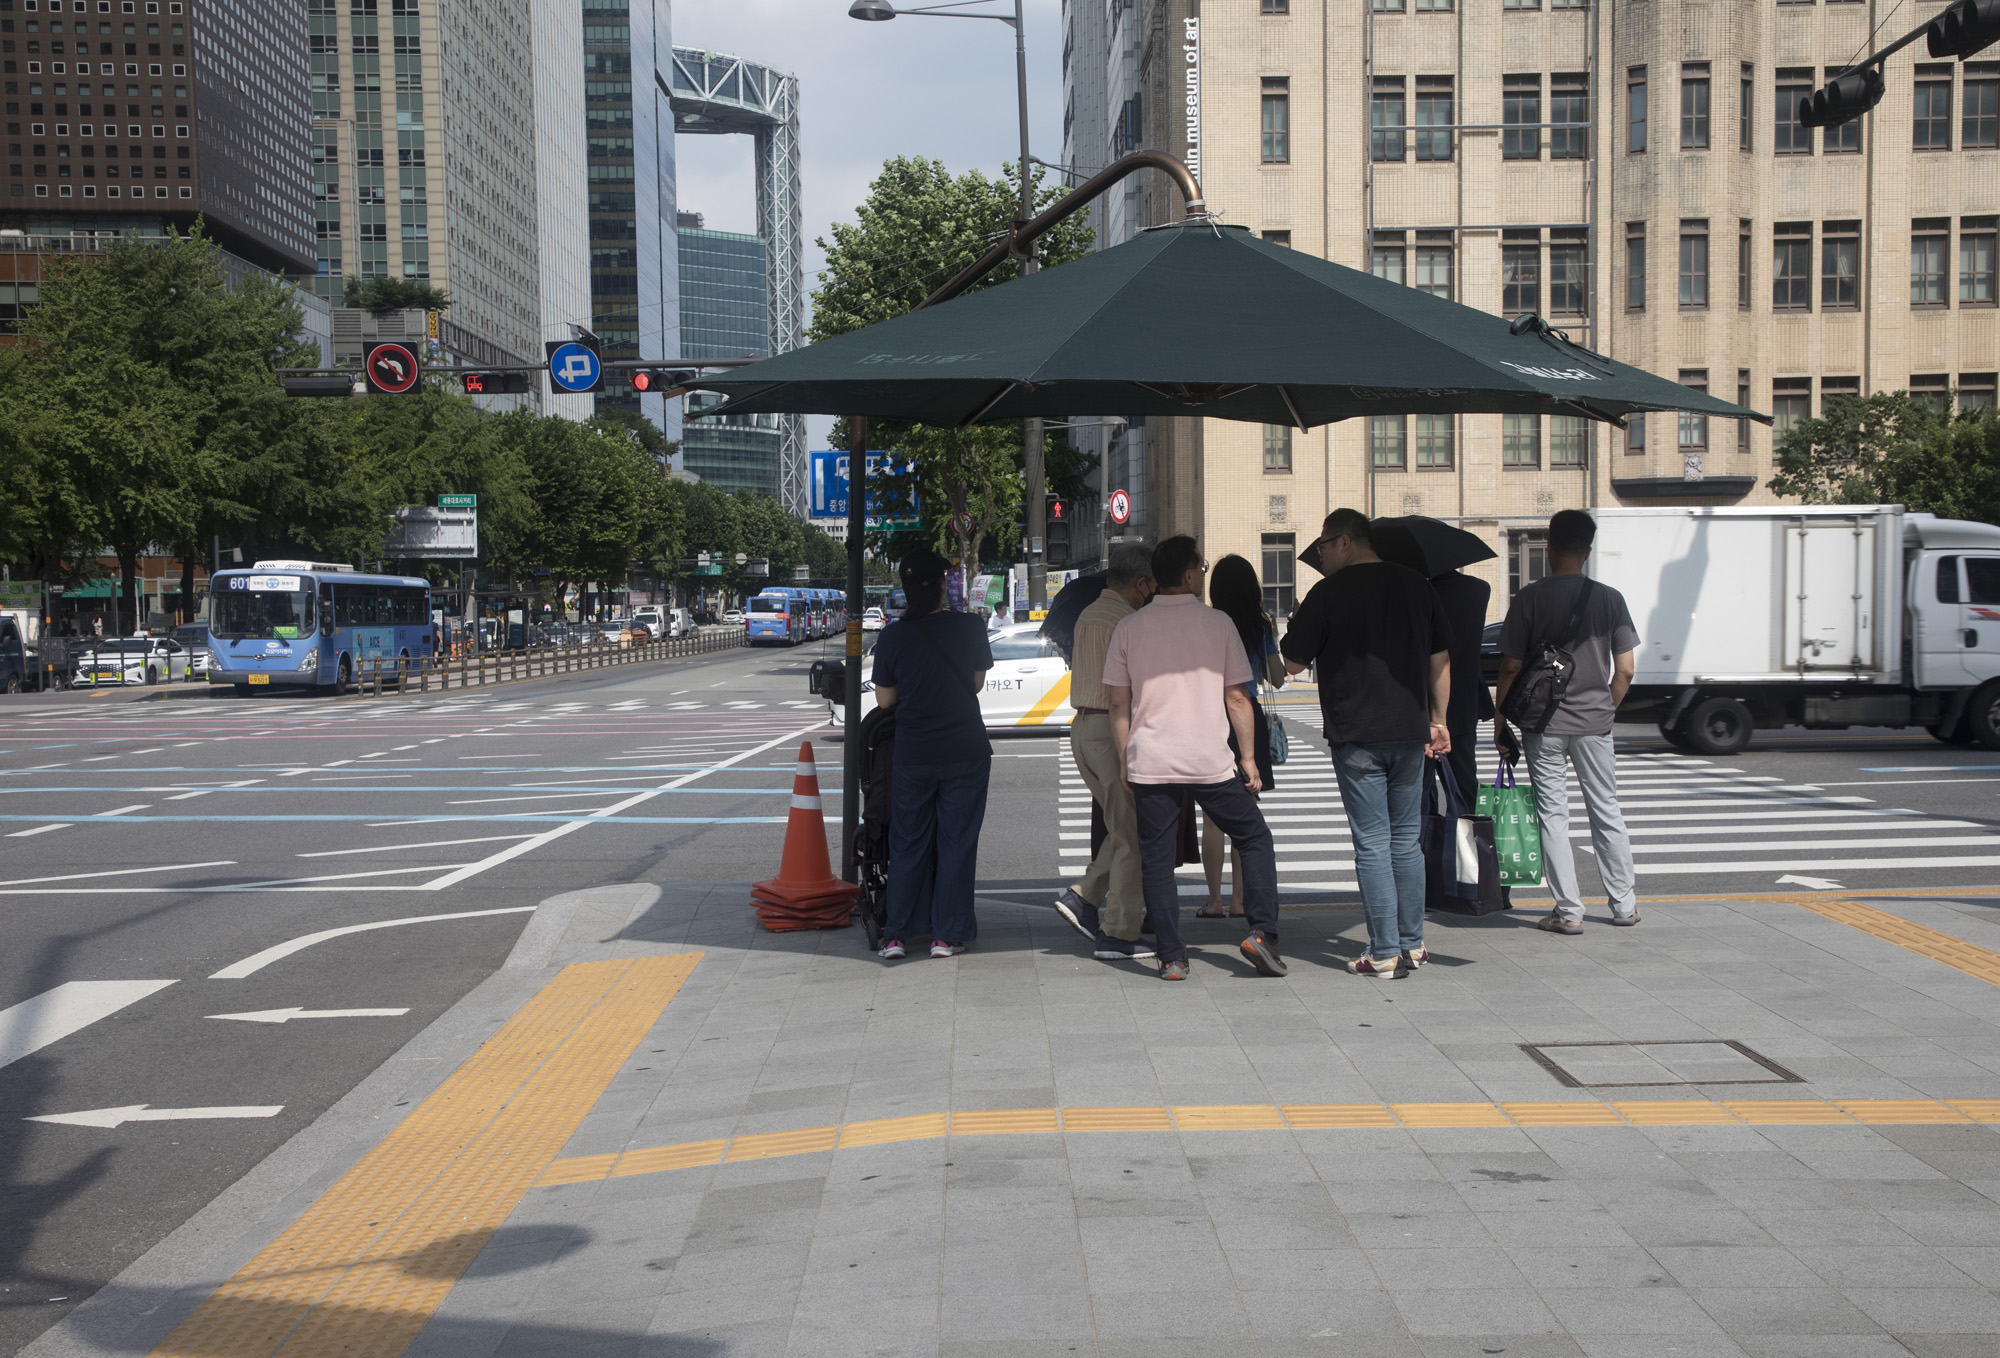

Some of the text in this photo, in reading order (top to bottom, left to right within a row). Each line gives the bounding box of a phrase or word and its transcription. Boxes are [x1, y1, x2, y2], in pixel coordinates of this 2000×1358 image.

[1183, 17, 1198, 180] min museum of art
[230, 577, 250, 590] 601
[1015, 680, 1023, 690] T
